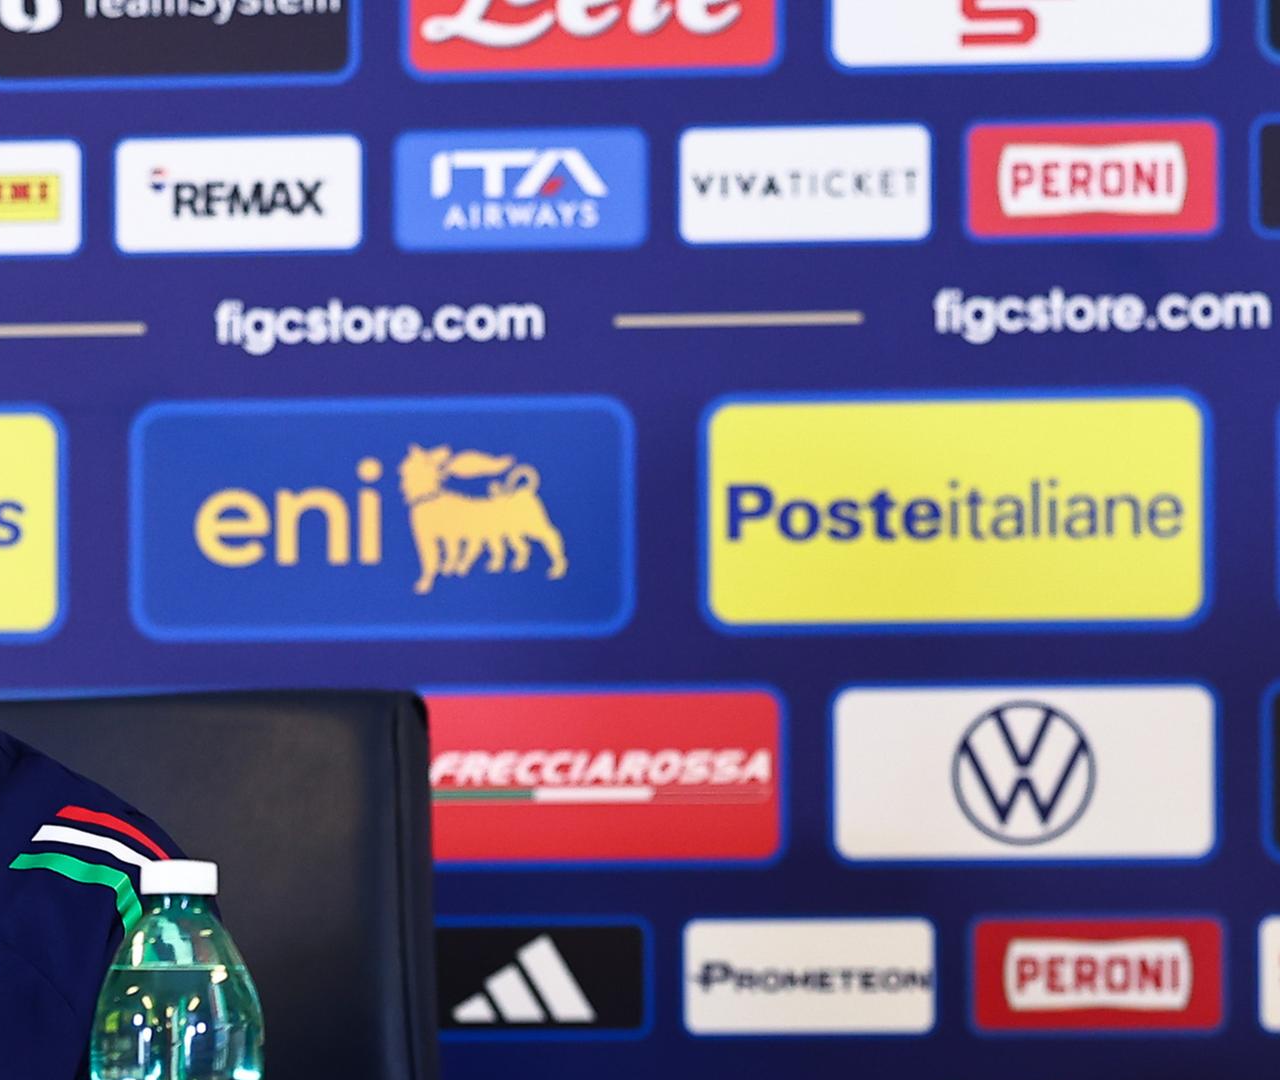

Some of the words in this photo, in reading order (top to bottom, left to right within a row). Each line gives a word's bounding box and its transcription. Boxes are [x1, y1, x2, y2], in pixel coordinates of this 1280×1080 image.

[430, 147, 608, 200] ITA
[692, 171, 918, 200] VIVATICKET
[1011, 160, 1174, 198] PERONI
[442, 199, 600, 231] AIRWAYS
[215, 299, 546, 355] figcstore.com
[933, 287, 1272, 344] figcstore.com
[195, 457, 382, 567] eni
[724, 477, 1186, 542] Posteitaliane
[429, 748, 772, 786] FRECCIAROSSA
[1017, 955, 1180, 995] PERONI
